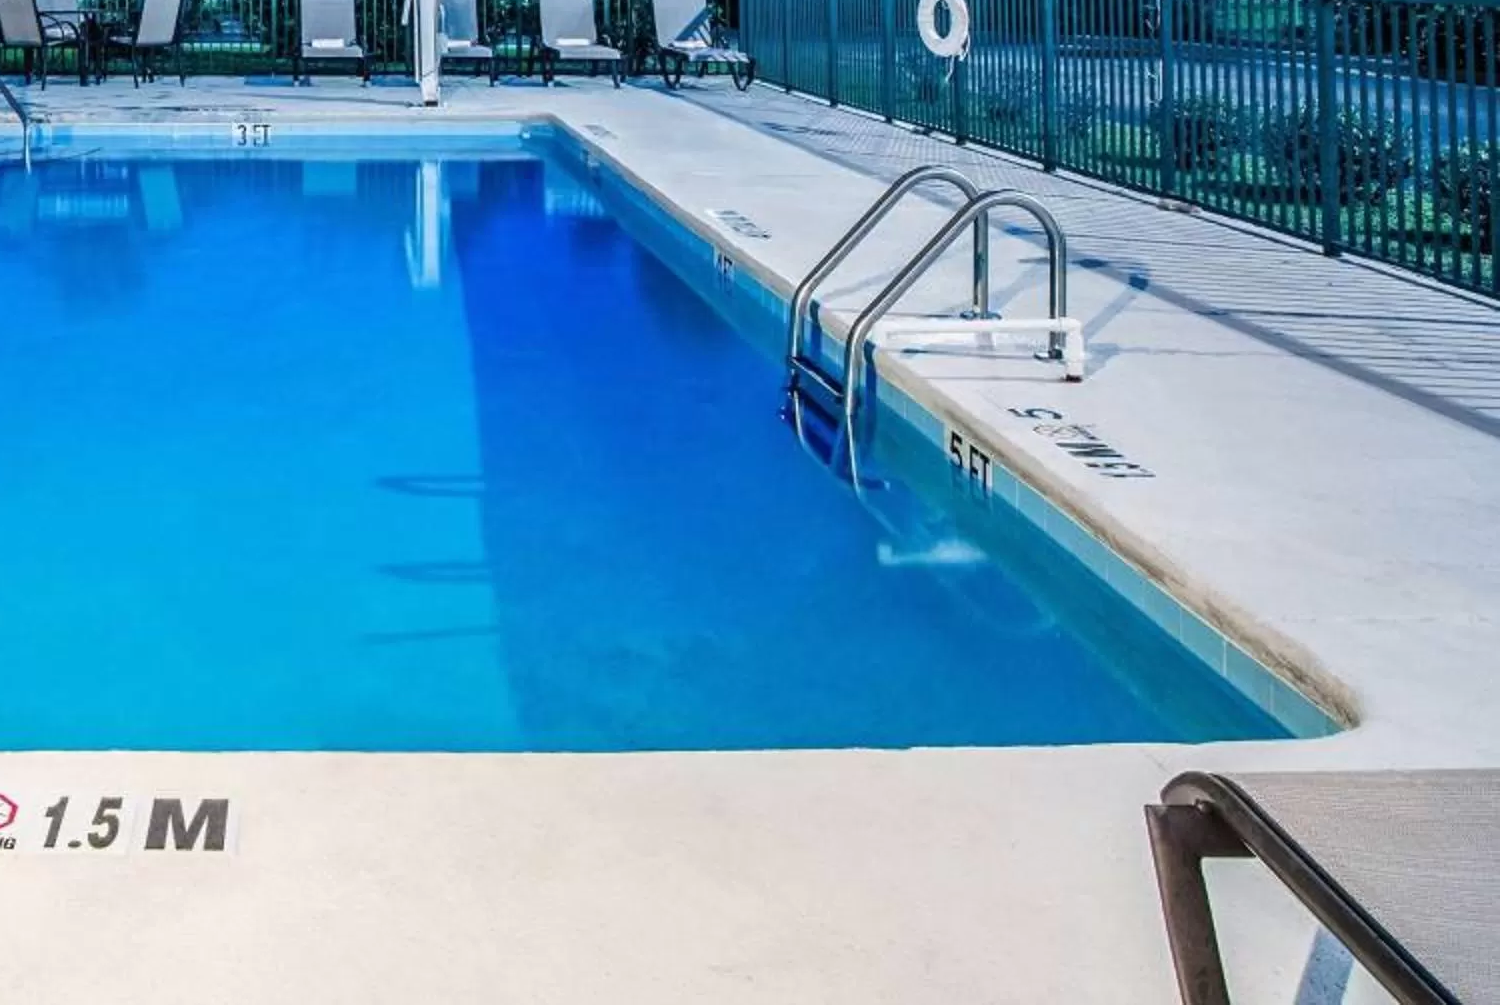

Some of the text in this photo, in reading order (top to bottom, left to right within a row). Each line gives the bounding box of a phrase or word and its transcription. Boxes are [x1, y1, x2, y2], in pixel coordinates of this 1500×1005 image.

[237, 124, 247, 147] 3
[950, 430, 991, 493] 5 FT
[41, 795, 124, 849] 1.5
[143, 798, 230, 851] M
